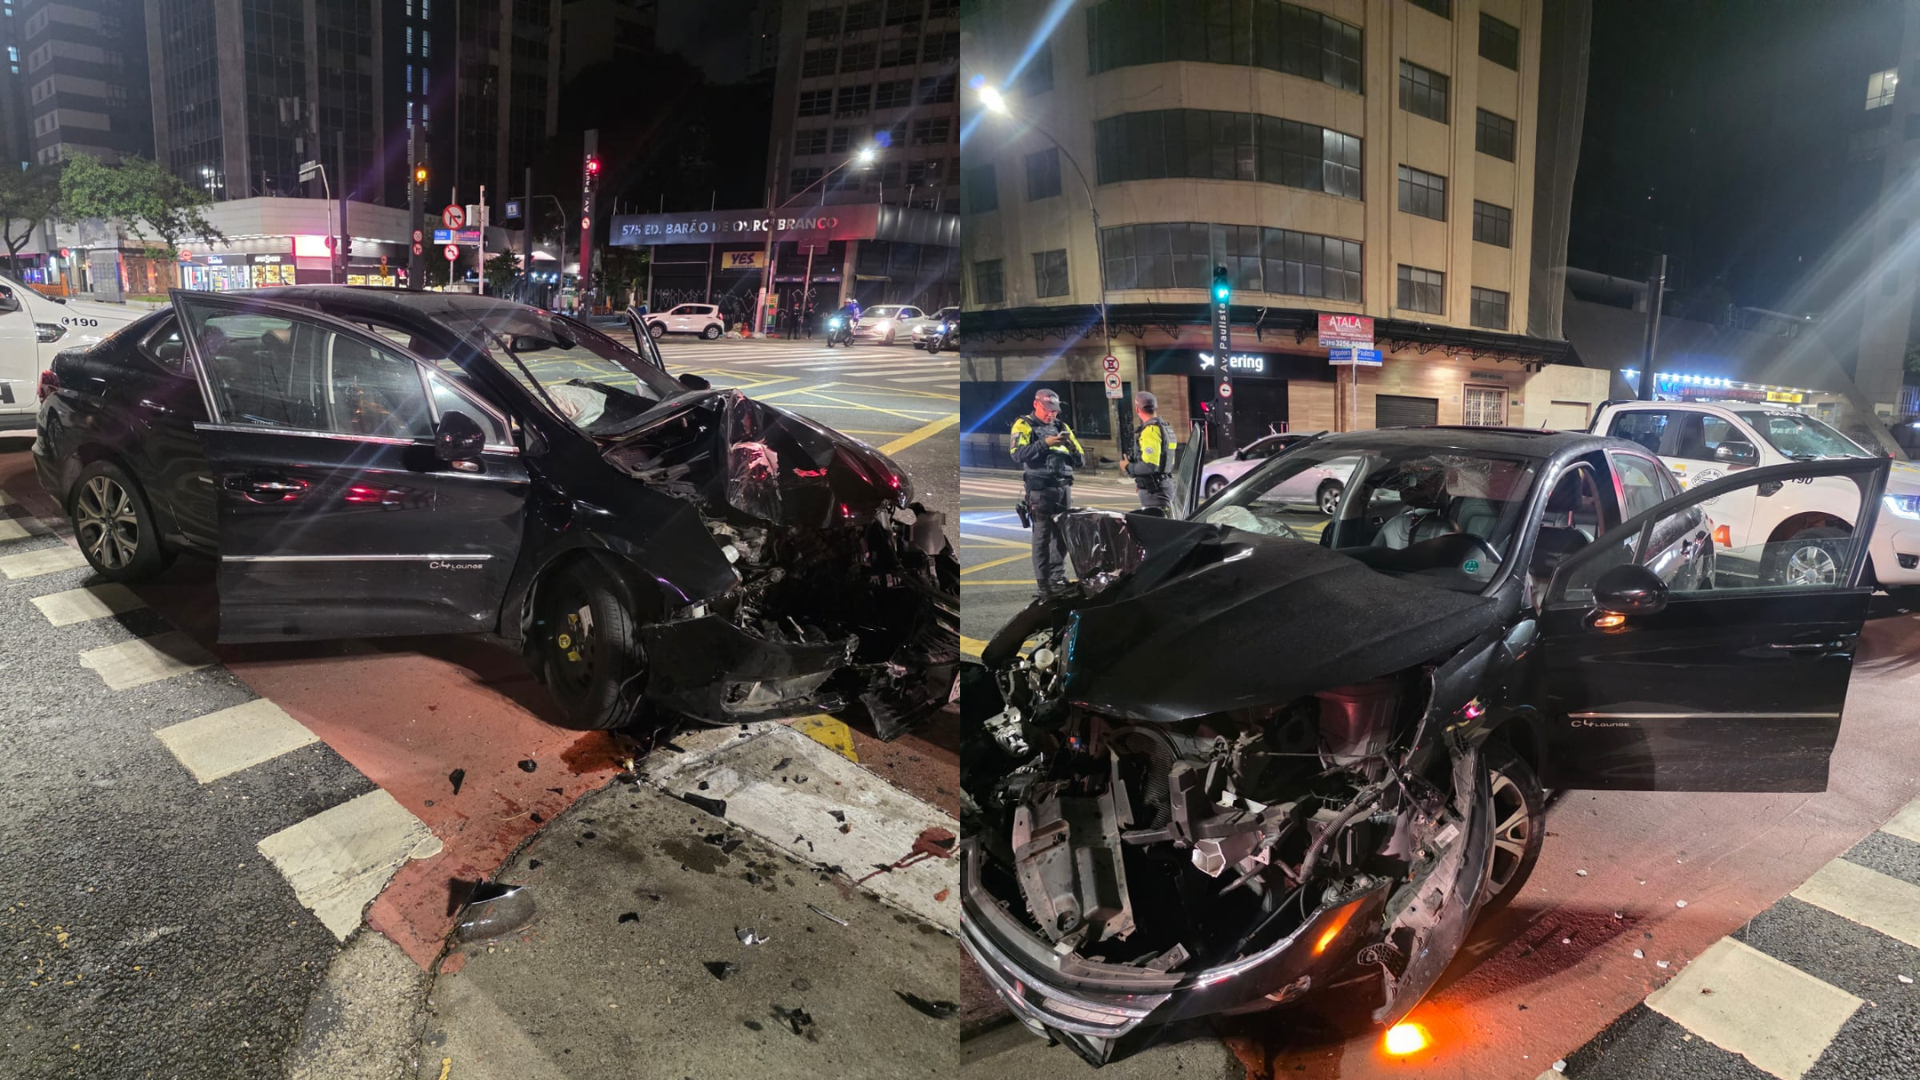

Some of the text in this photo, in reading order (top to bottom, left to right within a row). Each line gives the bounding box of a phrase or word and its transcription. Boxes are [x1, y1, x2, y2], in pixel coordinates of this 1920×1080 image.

[622, 224, 641, 236] 575
[644, 224, 662, 235] ED.
[665, 219, 708, 234] BARÃO
[777, 217, 839, 231] BRANCO
[731, 252, 755, 265] YES
[71, 317, 98, 327] 190
[1329, 316, 1361, 329] ATALA
[1218, 303, 1229, 372] Av. Paulista
[1229, 354, 1264, 372] ering
